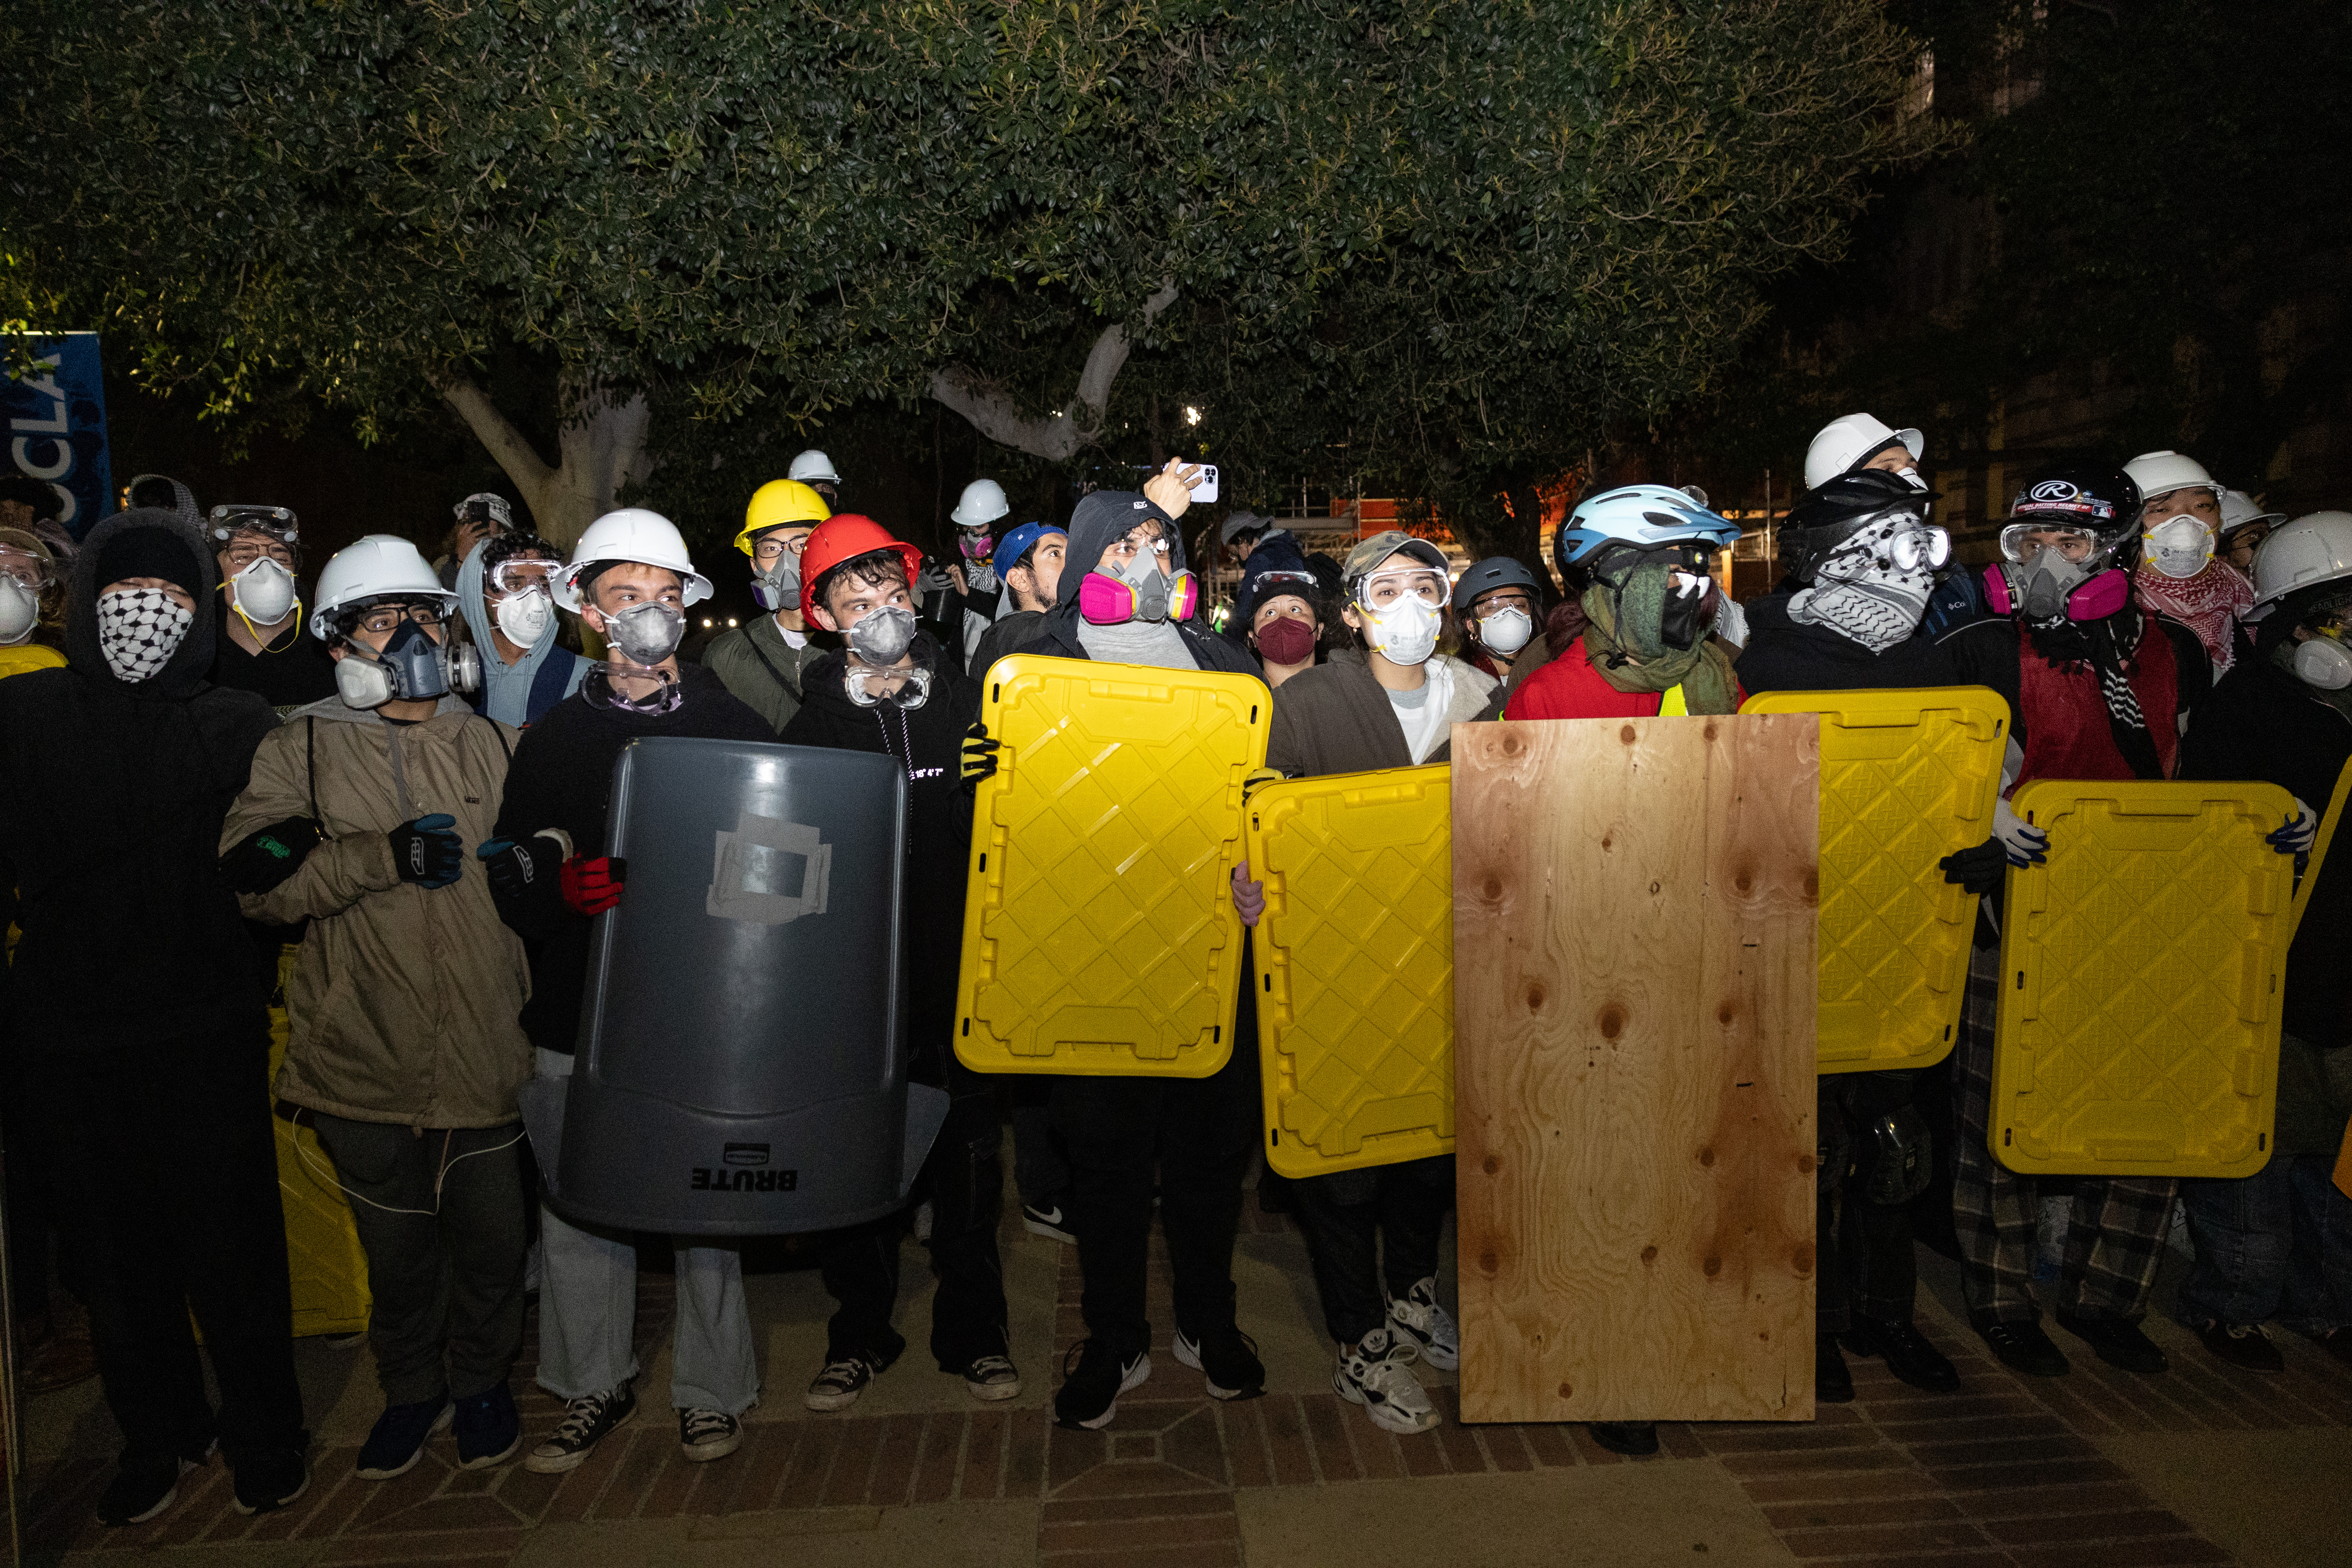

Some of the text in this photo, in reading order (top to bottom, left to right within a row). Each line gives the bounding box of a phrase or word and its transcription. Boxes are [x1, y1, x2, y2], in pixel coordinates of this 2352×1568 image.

[2034, 483, 2067, 498] R
[915, 768, 926, 778] 18°
[691, 1168, 797, 1192] BRUTE
